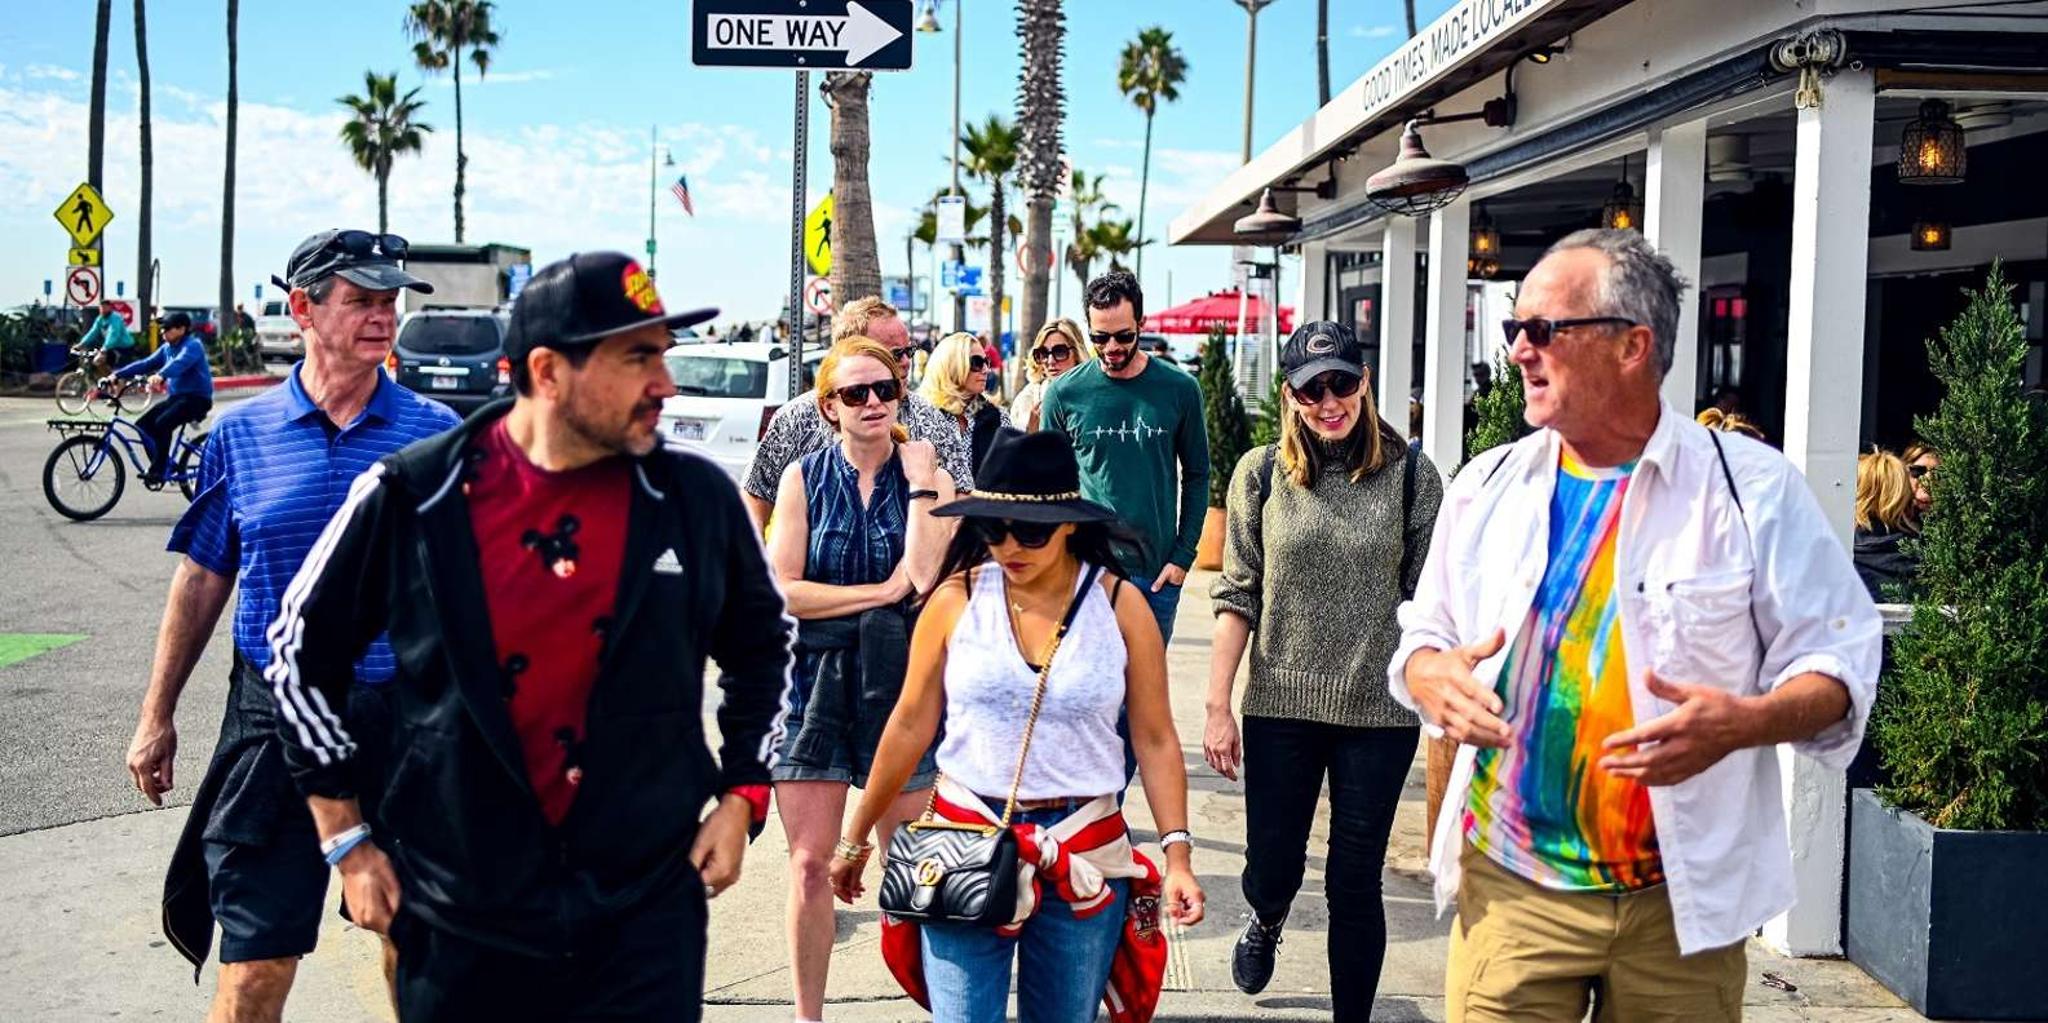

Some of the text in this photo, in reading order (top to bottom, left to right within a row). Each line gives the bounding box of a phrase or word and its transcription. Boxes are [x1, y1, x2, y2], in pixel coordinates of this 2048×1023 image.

[716, 18, 846, 47] ONE WAY
[1363, 66, 1392, 111] GOOD
[1431, 8, 1469, 66] MADE
